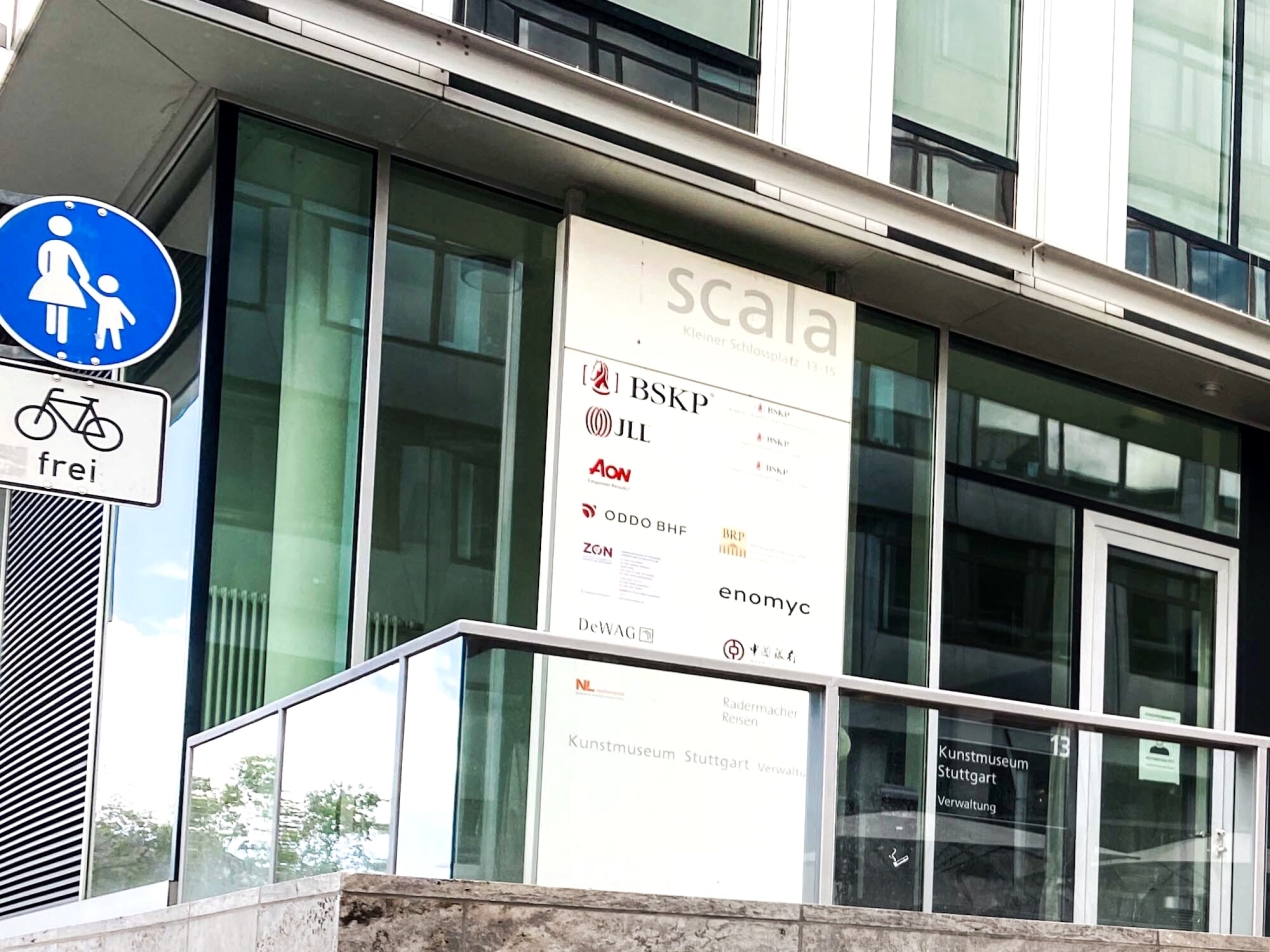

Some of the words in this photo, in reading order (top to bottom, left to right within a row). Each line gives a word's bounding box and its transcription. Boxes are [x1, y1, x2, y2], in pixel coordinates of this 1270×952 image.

[667, 266, 837, 357] scala
[683, 324, 727, 346] Kleiner
[730, 338, 800, 368] Schlossplatz
[630, 375, 709, 415] BSKP
[614, 418, 651, 443] JLL
[37, 451, 97, 483] frei
[604, 509, 652, 529] ODDO
[656, 520, 688, 536] BHF
[722, 527, 746, 542] BRP
[718, 585, 811, 617] enomyc
[578, 617, 636, 641] DeWAG
[722, 696, 799, 720] Radermacher
[722, 711, 758, 728] Reisen
[568, 733, 676, 761] Kunstmuseum
[684, 749, 751, 771] Stuttgart
[938, 745, 1029, 771] Kunstmuseum
[1050, 735, 1070, 758] 13
[938, 764, 997, 786] Stuttgart
[937, 796, 997, 815] Verwaltung
